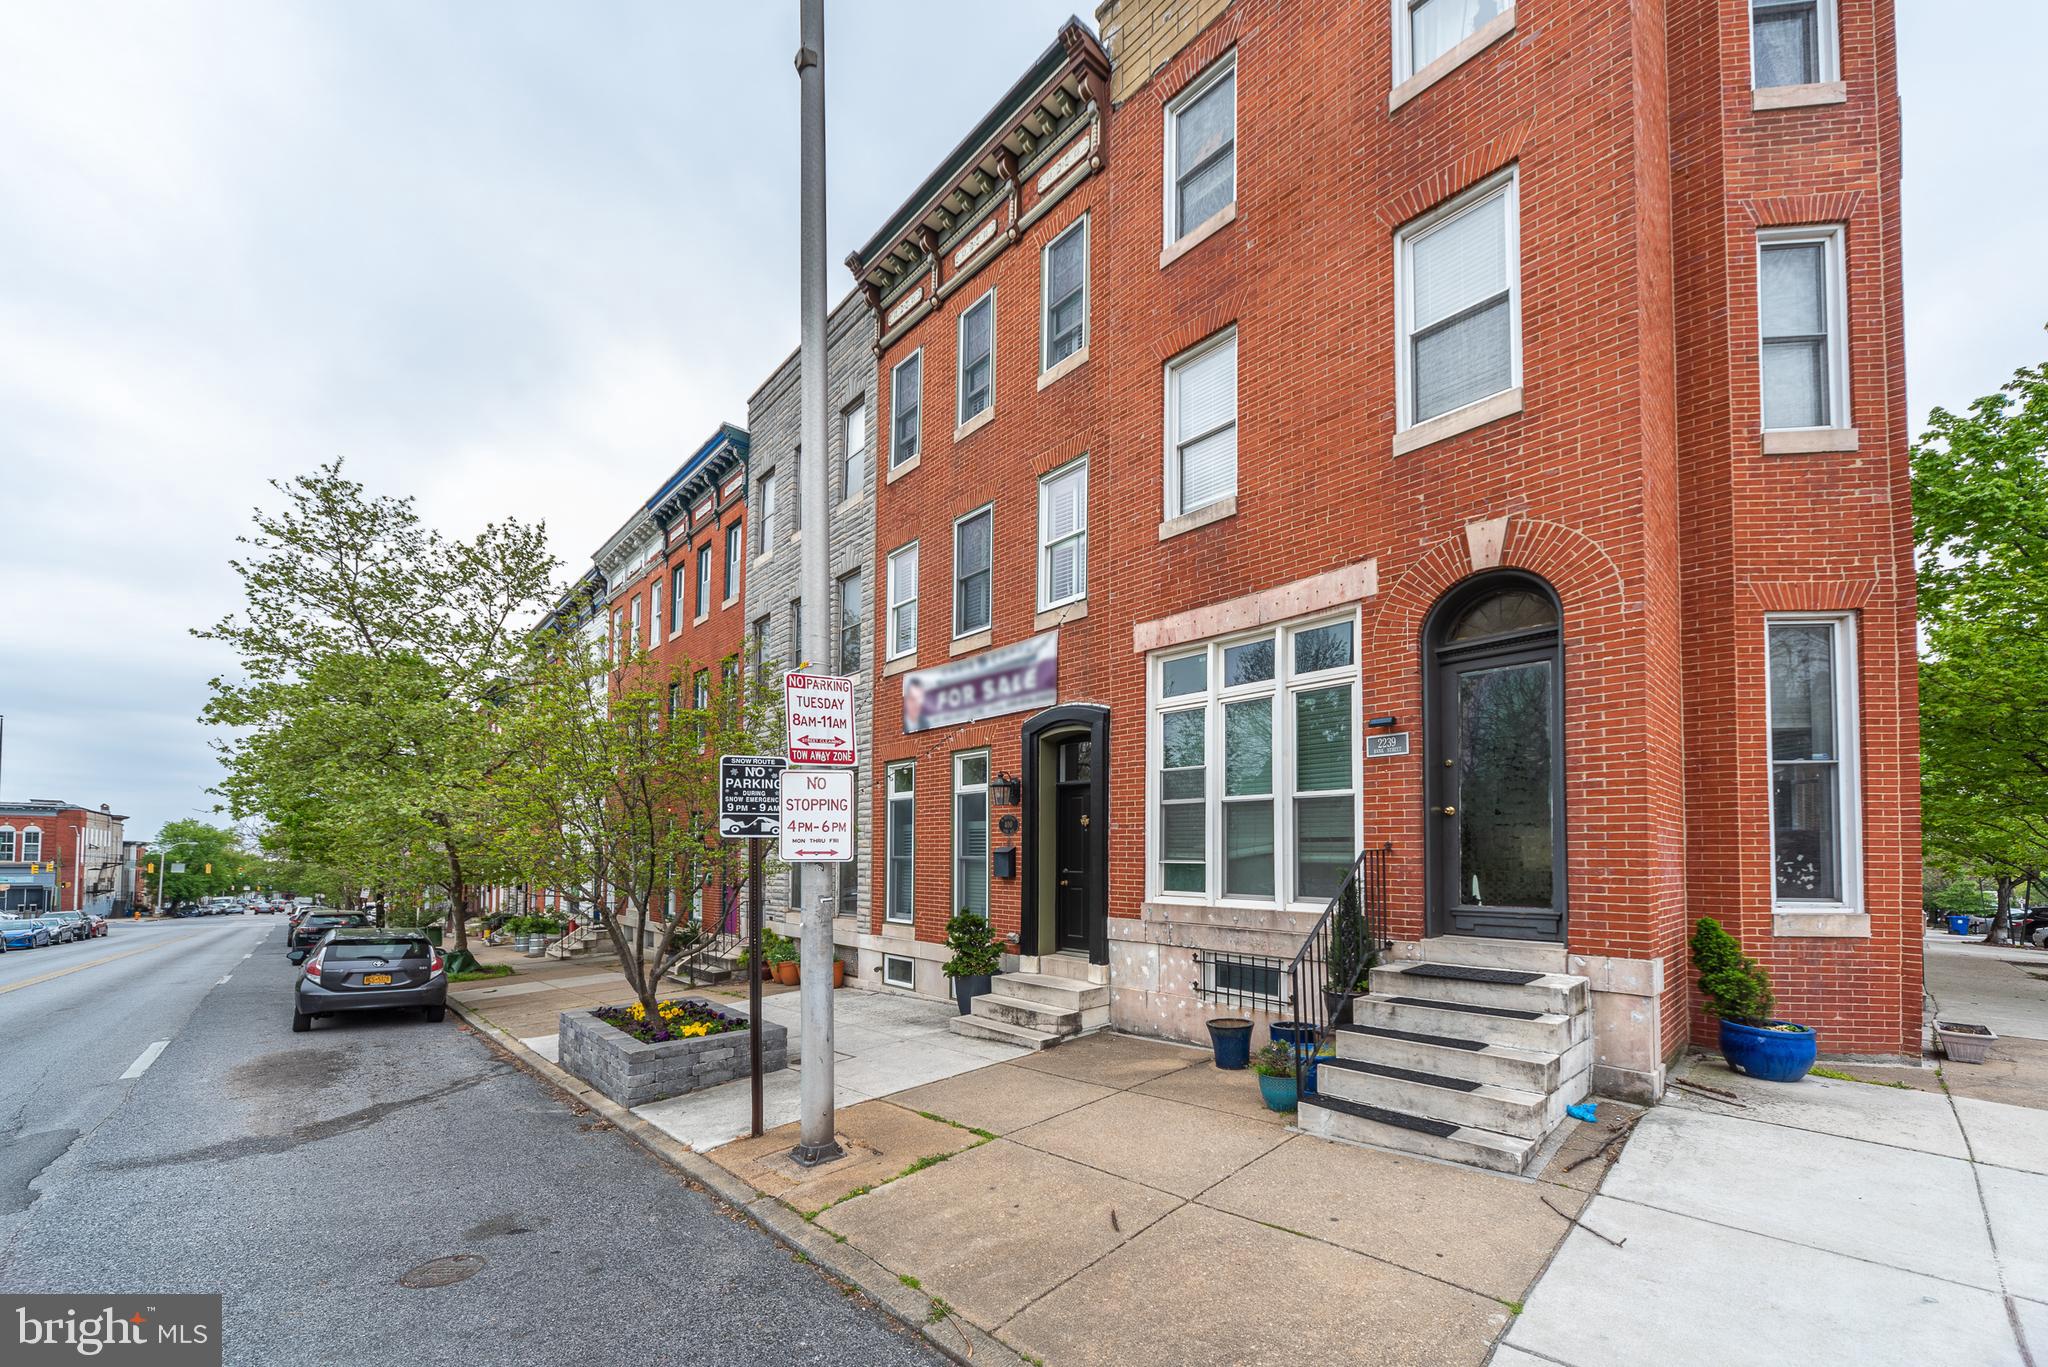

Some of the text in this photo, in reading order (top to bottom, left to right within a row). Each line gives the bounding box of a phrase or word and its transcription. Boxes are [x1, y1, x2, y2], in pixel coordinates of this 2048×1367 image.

[789, 676, 850, 692] NO PARKING
[936, 684, 976, 710] FOR
[982, 667, 1038, 700] SALE
[796, 696, 844, 710] TUESDAY
[792, 713, 847, 728] 8AM-11AM
[1378, 737, 1397, 748] 2239
[792, 750, 853, 762] TOW AWAY ZONE
[745, 767, 765, 777] NO
[806, 776, 826, 790] NO
[786, 798, 848, 811] STOPPING
